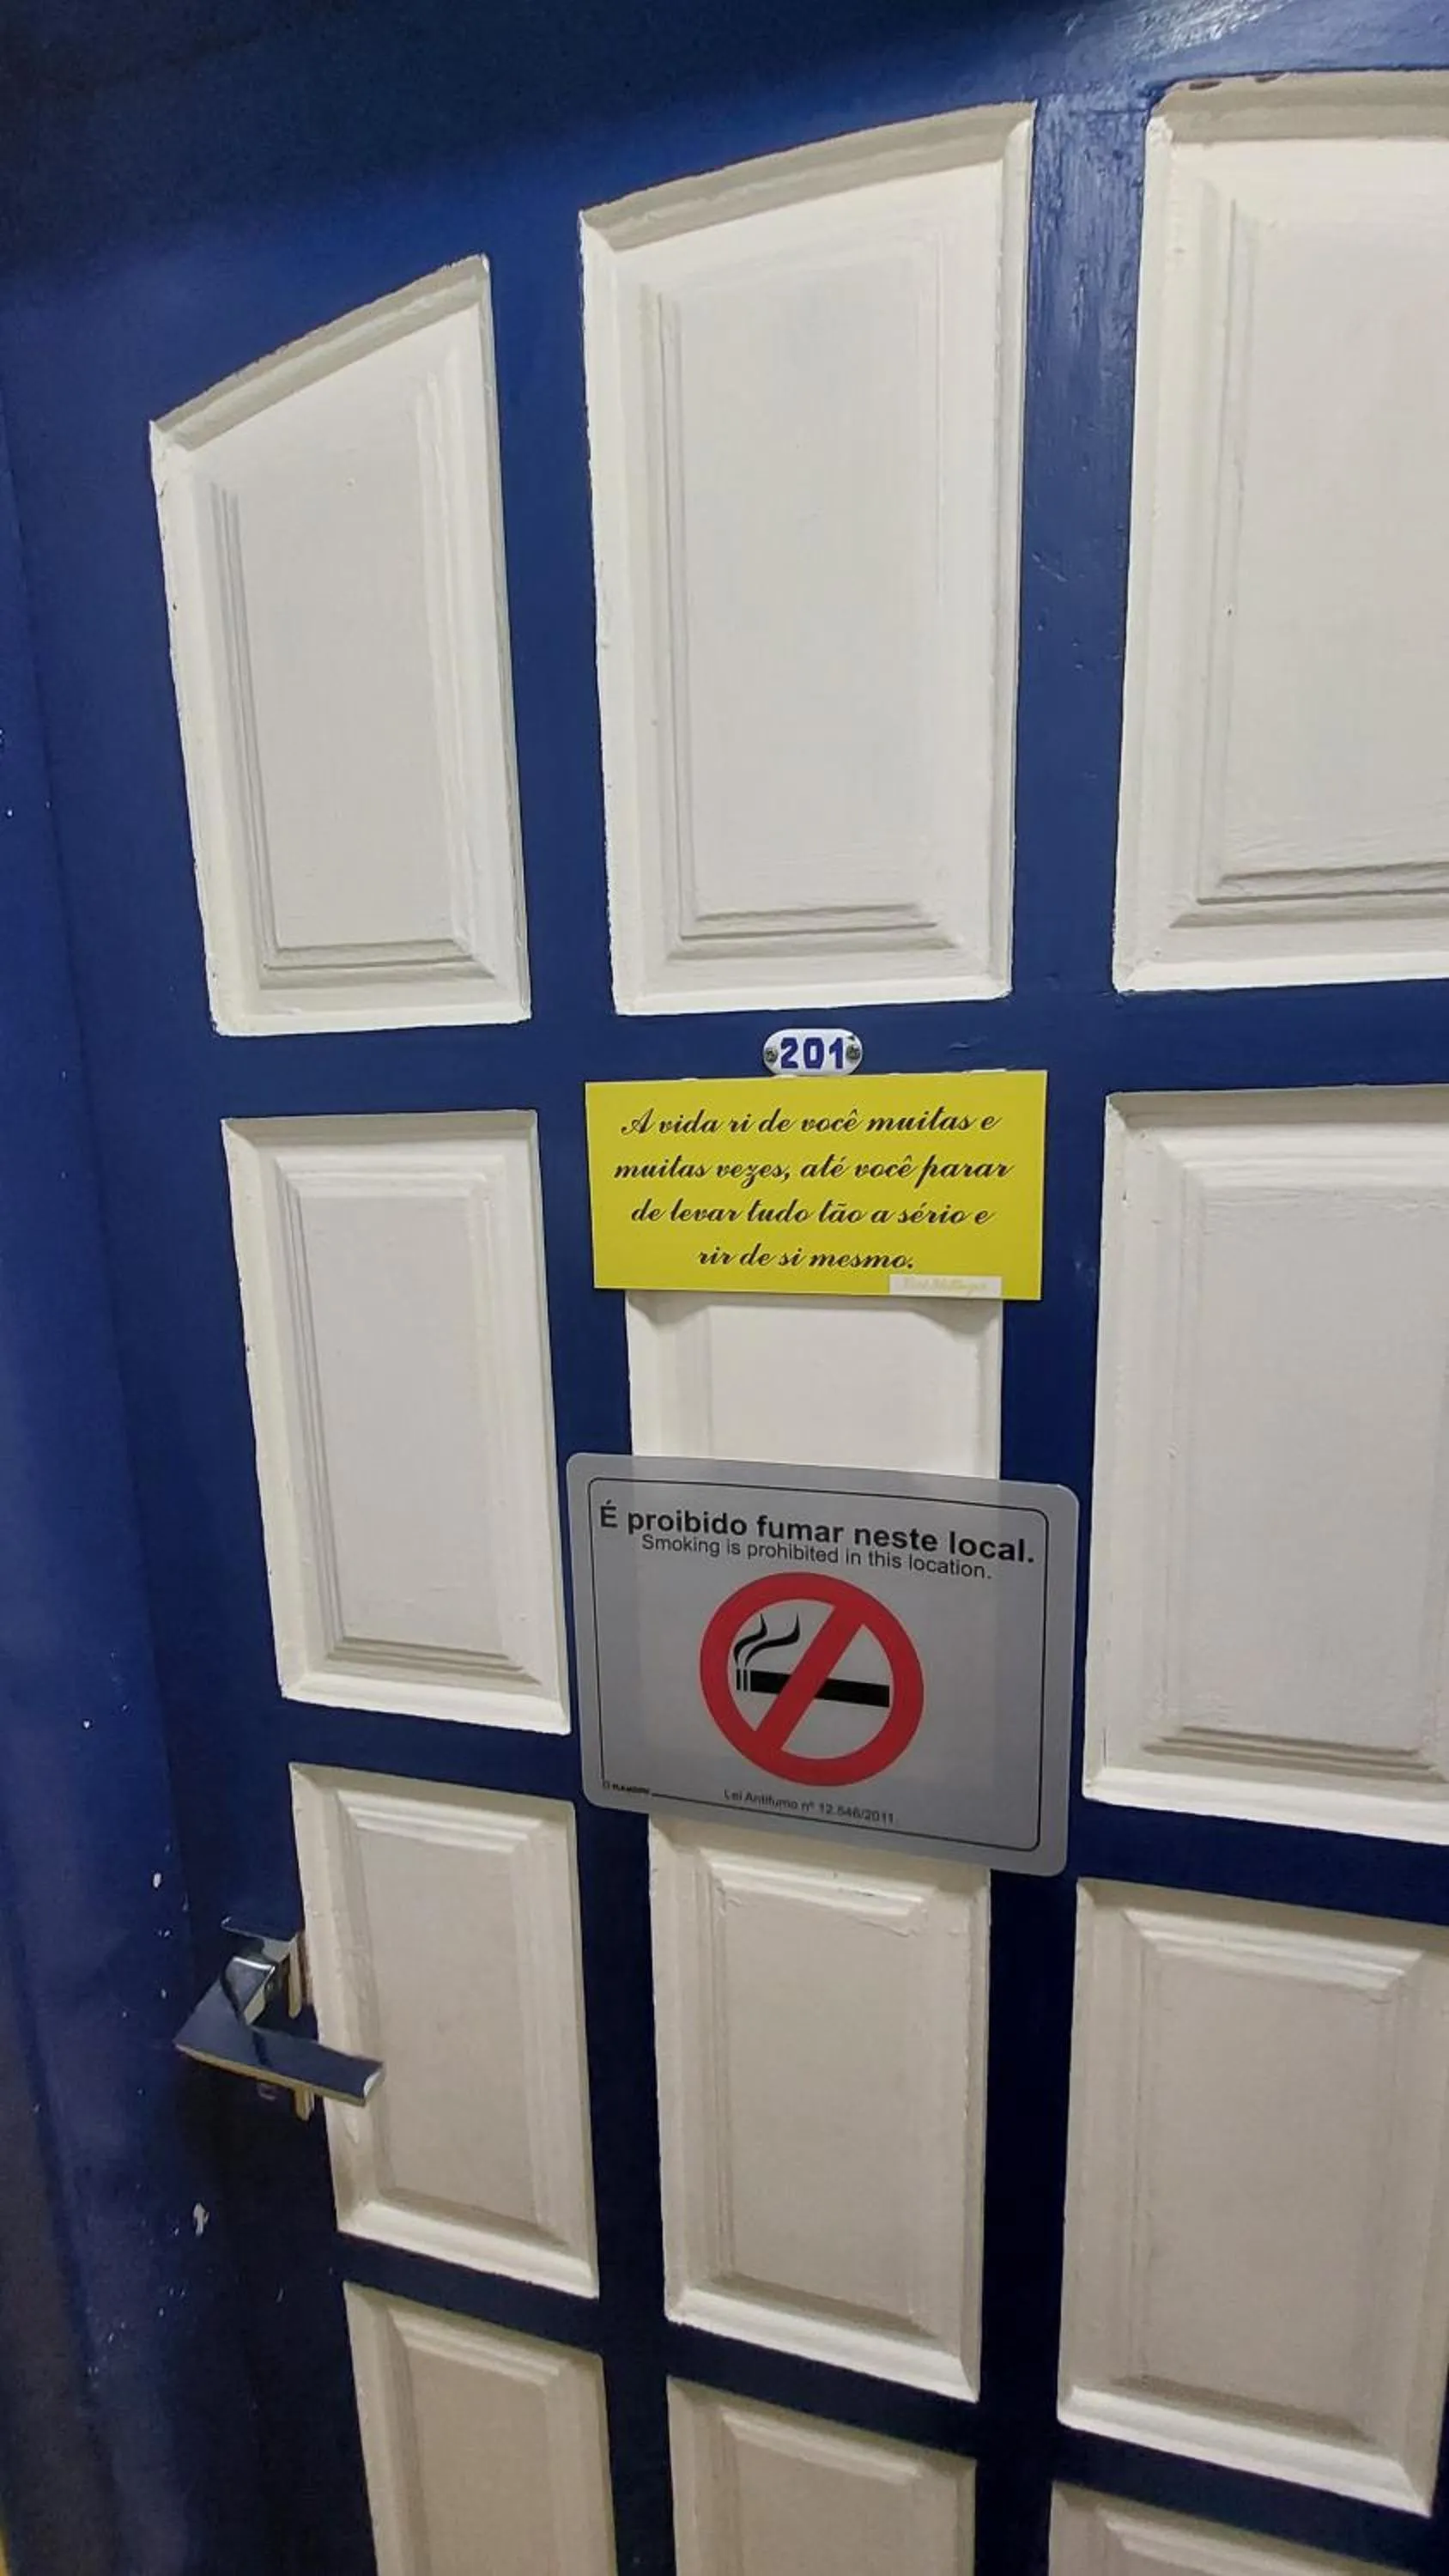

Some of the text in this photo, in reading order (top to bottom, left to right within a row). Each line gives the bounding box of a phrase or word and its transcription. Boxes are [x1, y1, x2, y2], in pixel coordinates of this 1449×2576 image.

[780, 1036, 844, 1070] 201
[621, 1105, 1003, 1135] A vida ri de você muitas e
[614, 1153, 1015, 1189] muitas vezes, até você parar
[631, 1197, 997, 1224] de levar tudo tão a sério e
[699, 1242, 914, 1268] rir de si mesmo.
[600, 1499, 1034, 1563] É proibido fumar neste local.
[642, 1534, 991, 1580] Smoking is prohibited in this location.
[724, 1789, 743, 1801] Lei
[745, 1790, 798, 1811] Antifumo
